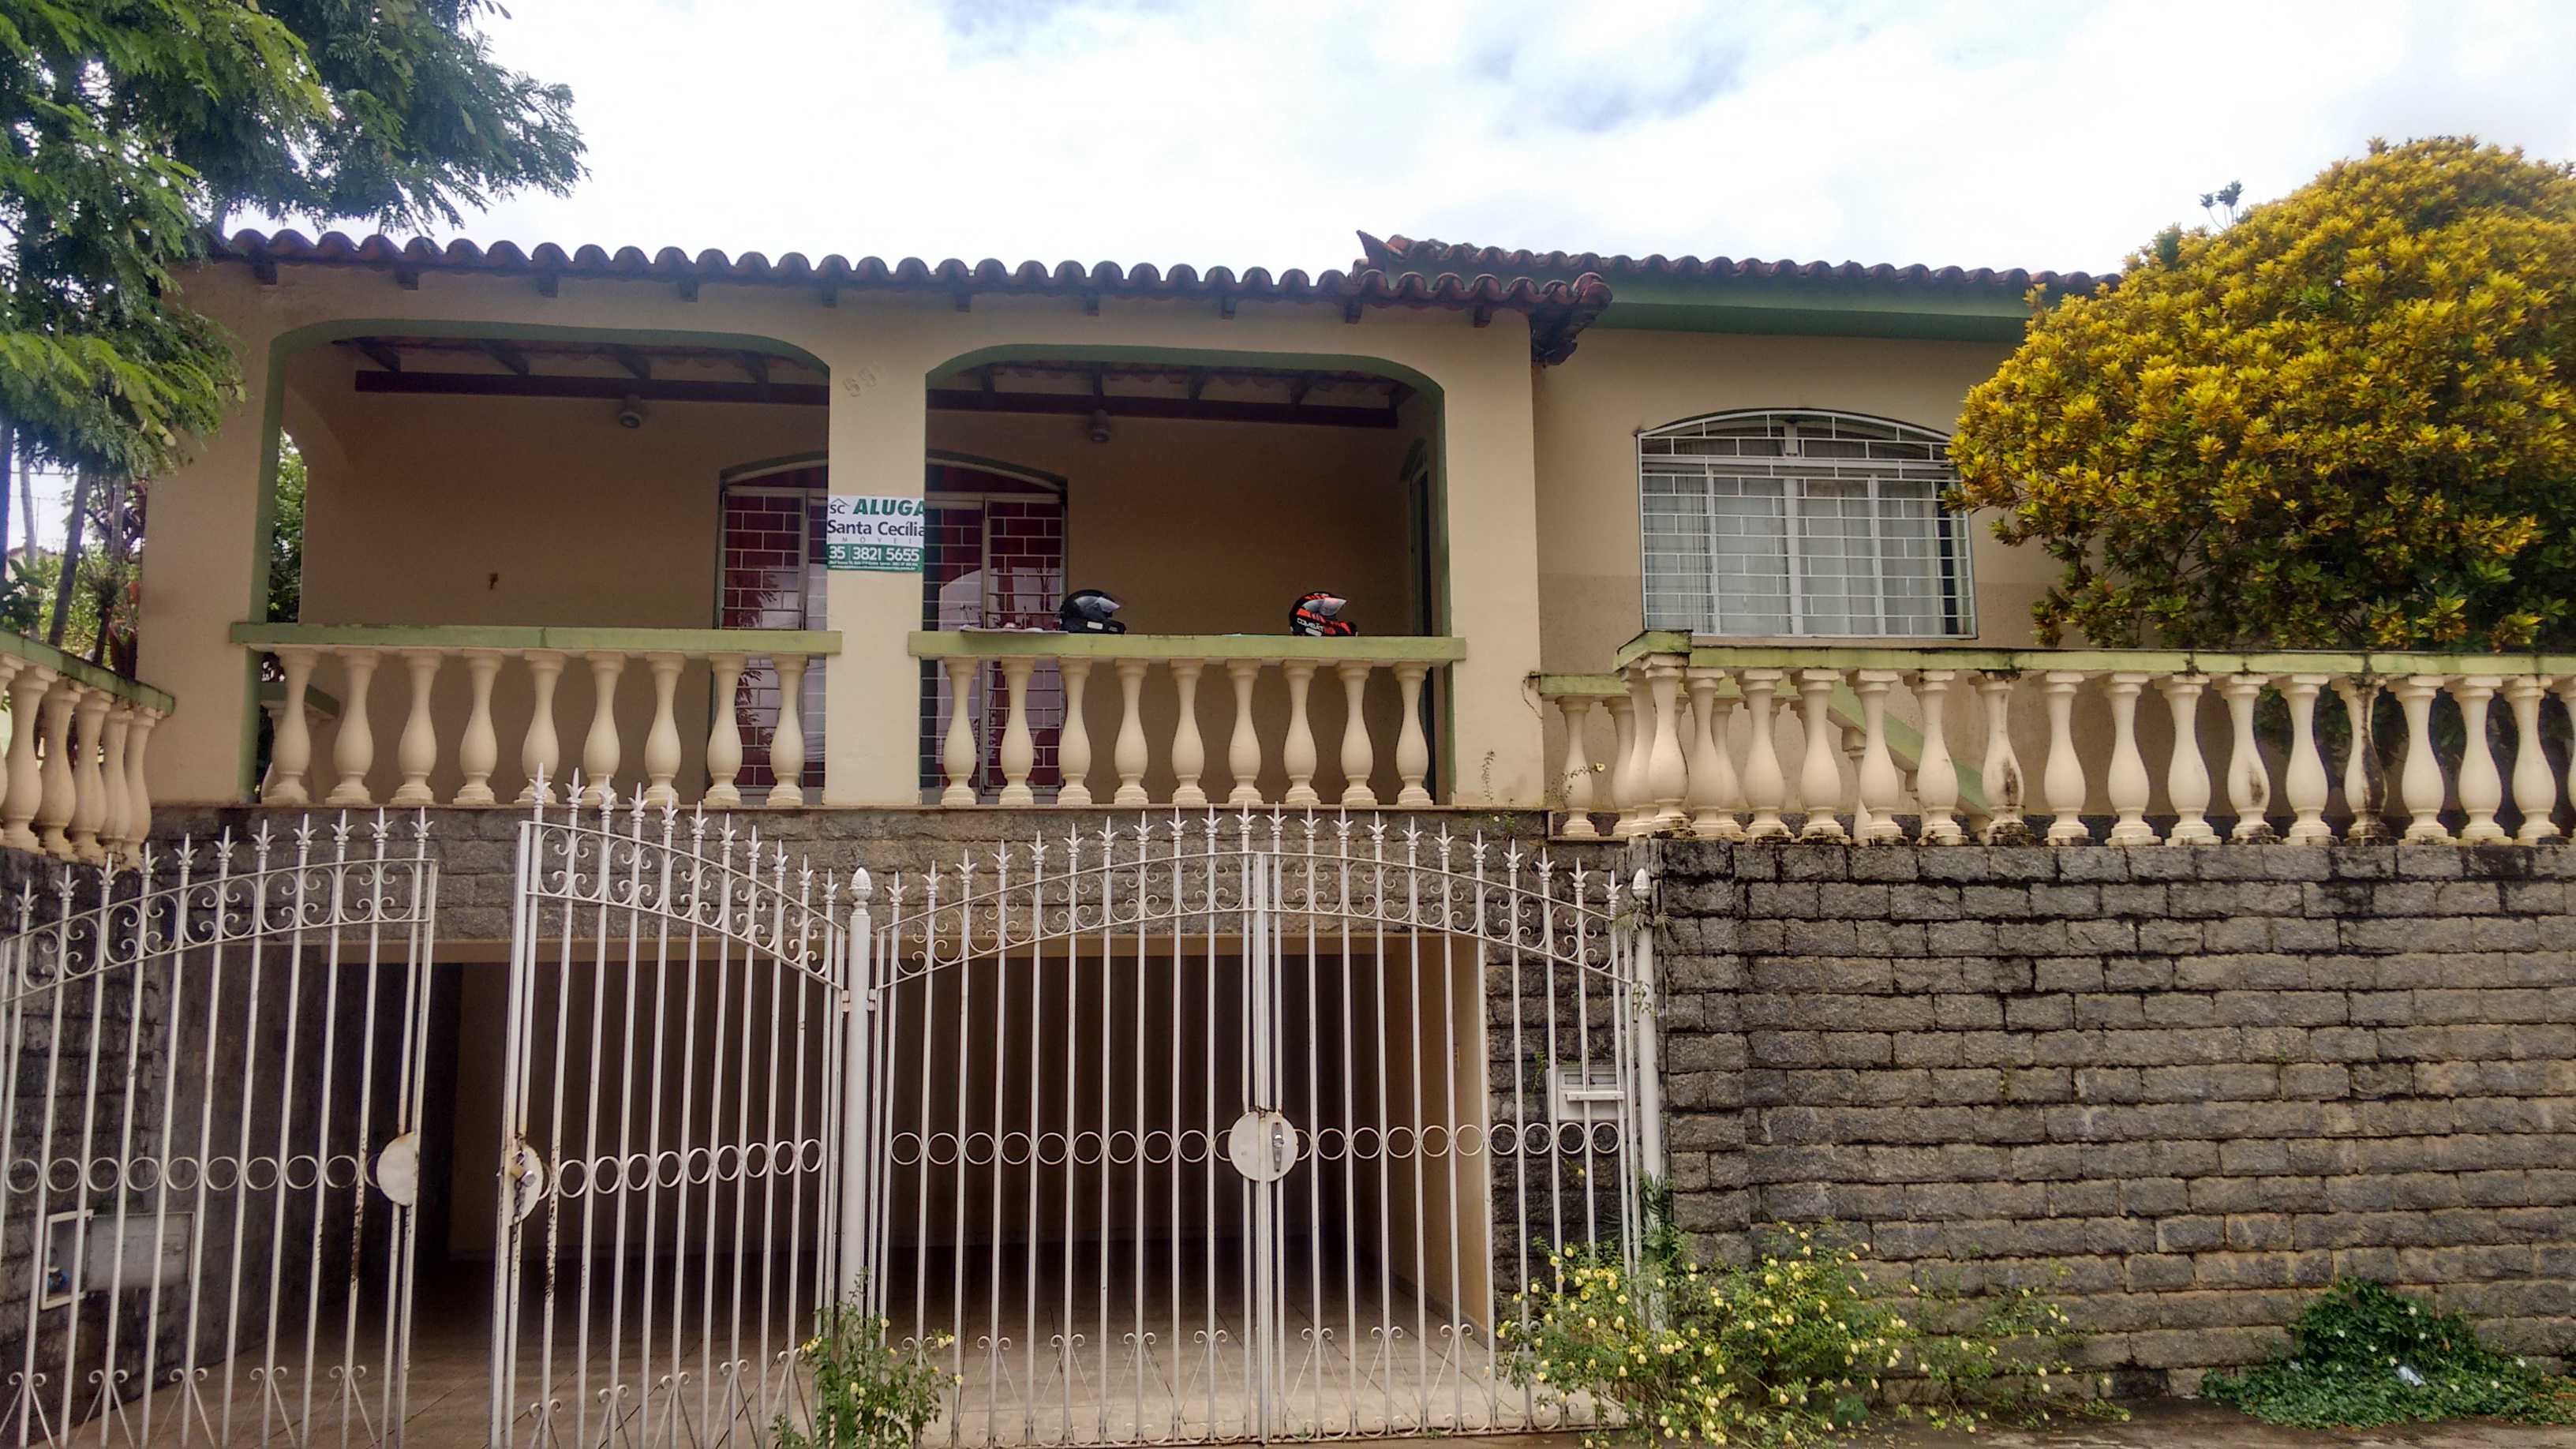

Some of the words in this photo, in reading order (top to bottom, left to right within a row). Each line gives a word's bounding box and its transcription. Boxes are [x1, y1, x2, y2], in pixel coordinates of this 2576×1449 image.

[852, 498, 924, 516] ALUGA
[827, 519, 872, 535] Santa
[878, 521, 925, 537] Cecília
[829, 545, 846, 560] 35
[852, 546, 882, 561] 3821
[886, 548, 920, 562] 5655
